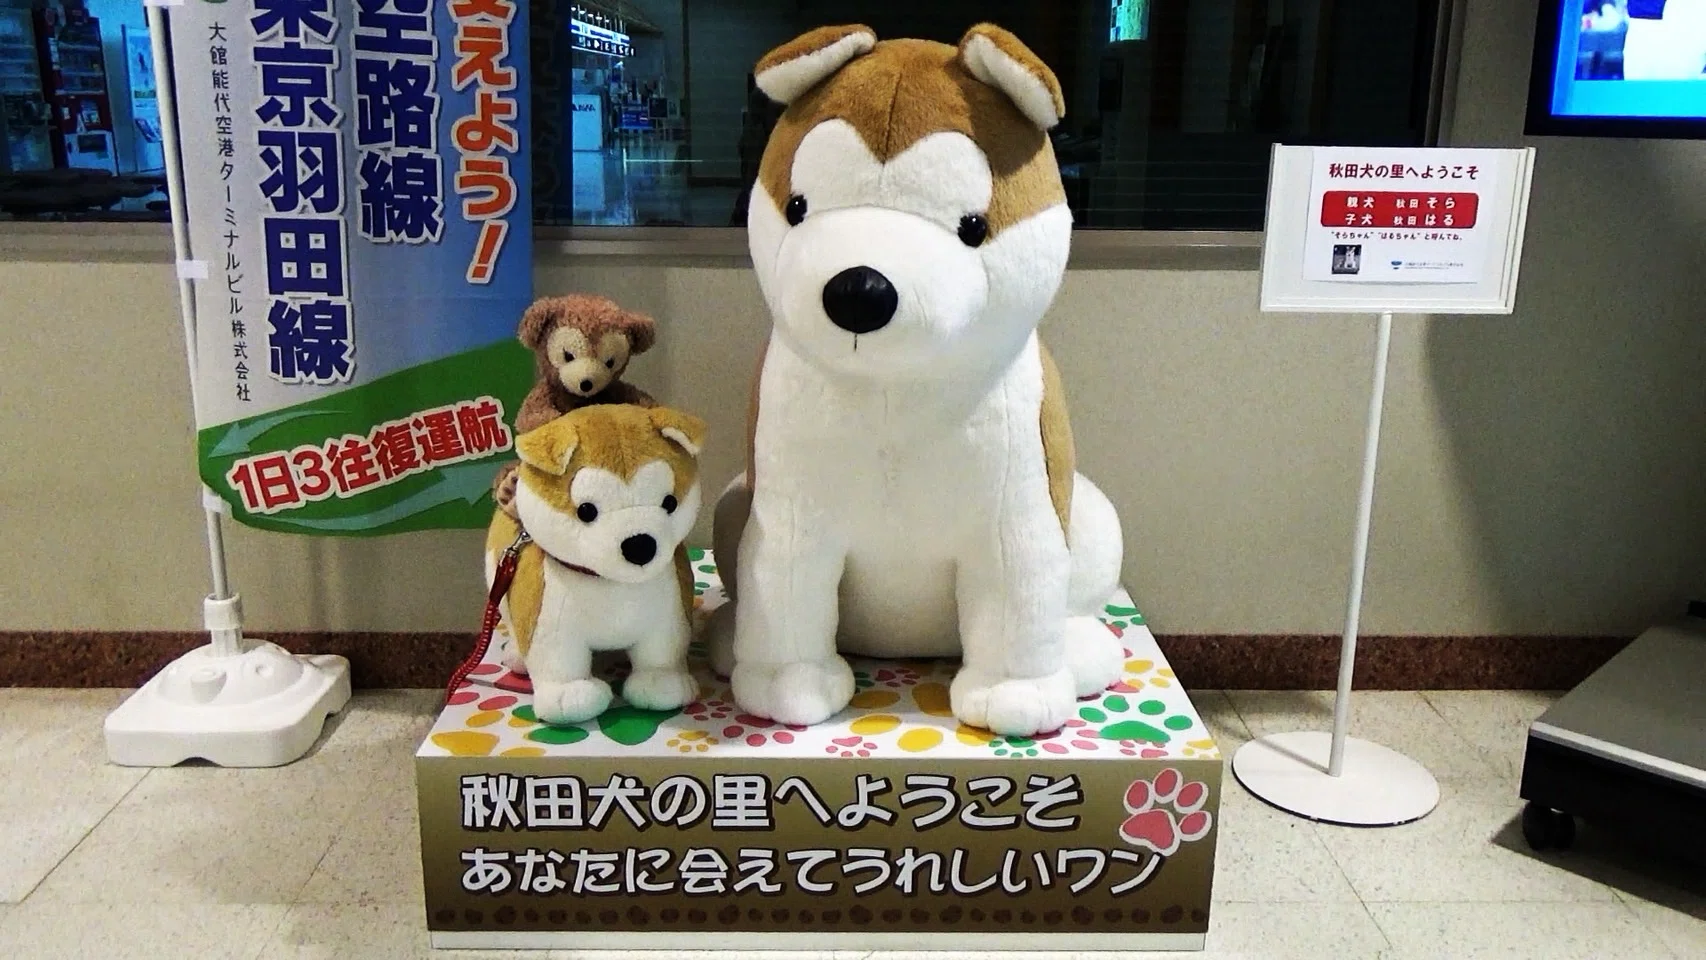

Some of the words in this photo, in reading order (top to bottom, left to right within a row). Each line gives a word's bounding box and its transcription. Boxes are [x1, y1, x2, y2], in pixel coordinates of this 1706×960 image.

[1328, 163, 1479, 180] 秋田犬の里へようこそ
[208, 21, 252, 402] 大館能代空港ターミナルビル株式会社
[231, 401, 509, 509] 1日3往復運航
[461, 774, 1081, 829] 秋田犬の里へようこそ
[460, 848, 1161, 895] あなたに会えてうれしいワン
